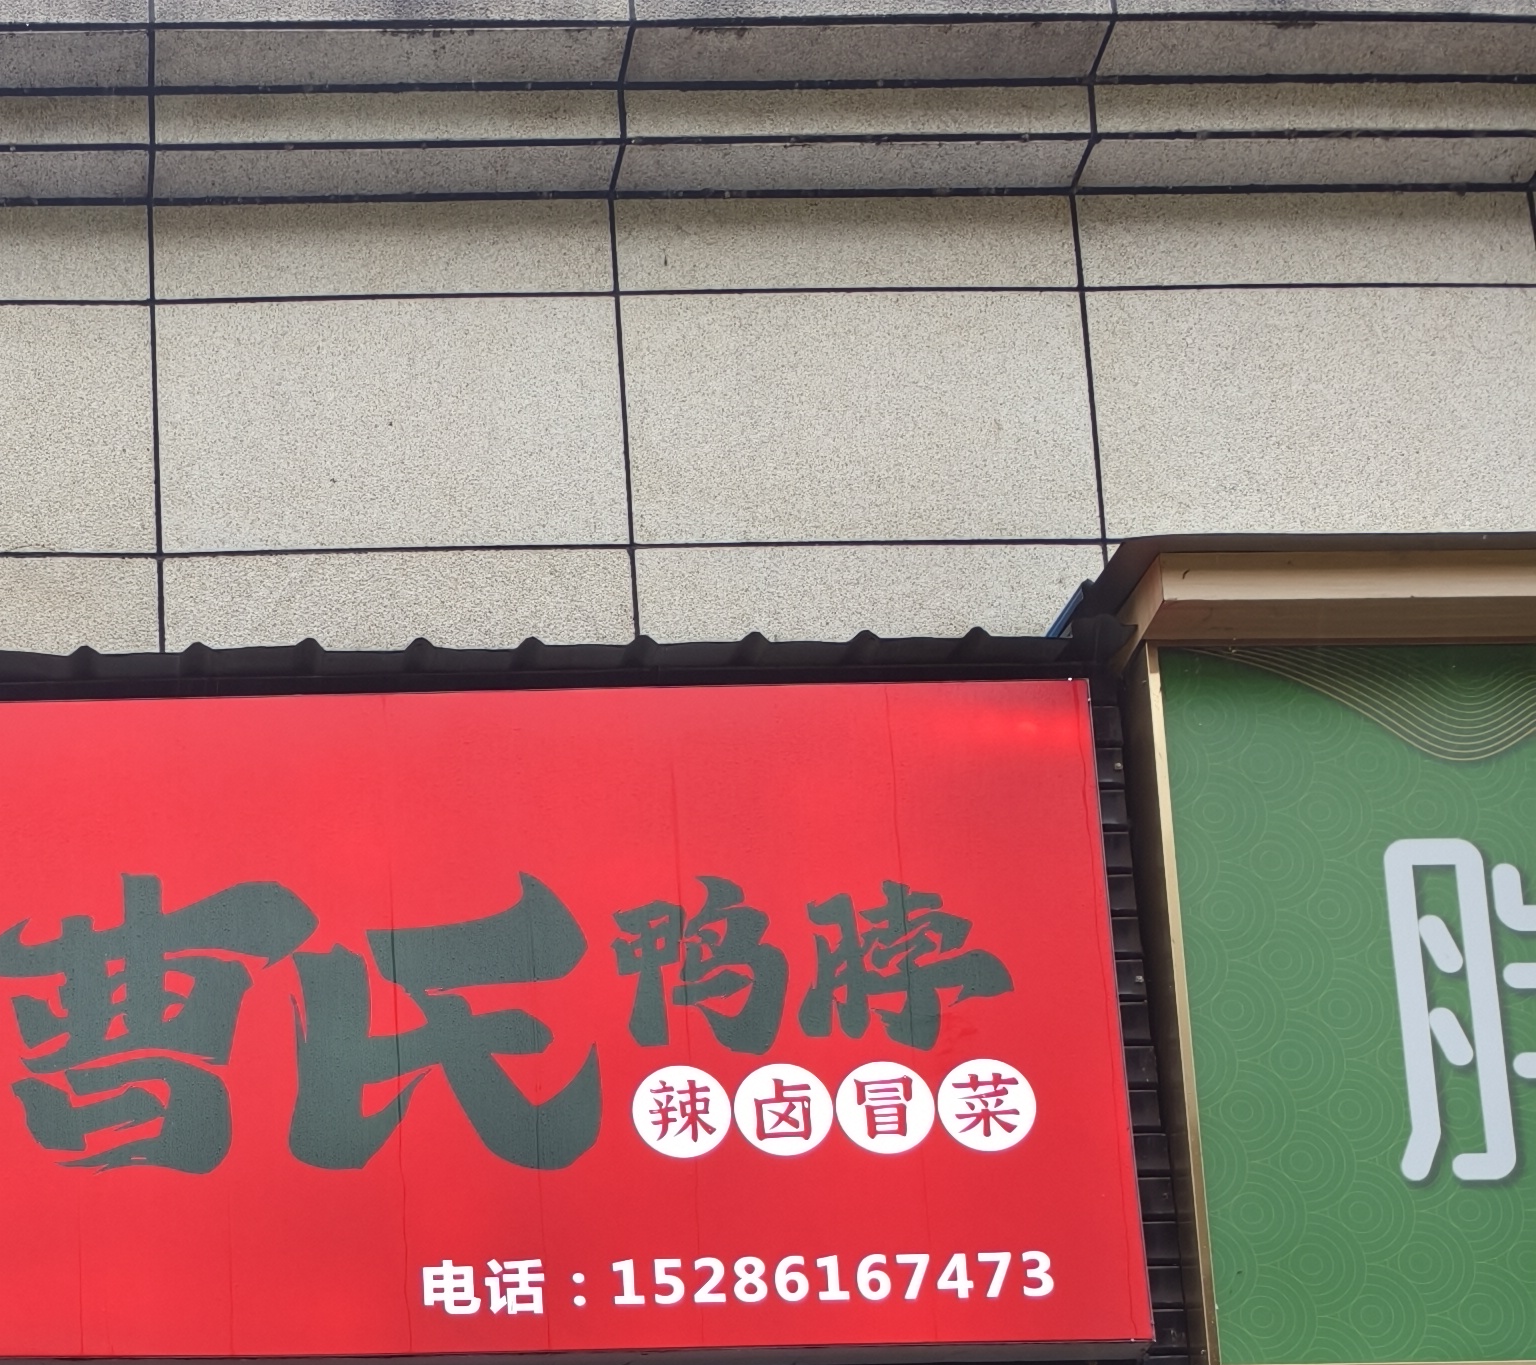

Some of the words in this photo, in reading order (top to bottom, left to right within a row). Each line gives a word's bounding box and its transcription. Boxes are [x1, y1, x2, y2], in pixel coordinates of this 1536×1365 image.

[612, 876, 1014, 1056] 鸭脖
[642, 1066, 1028, 1150] 辣卤冒菜
[611, 1249, 1056, 1306] 15286167473
